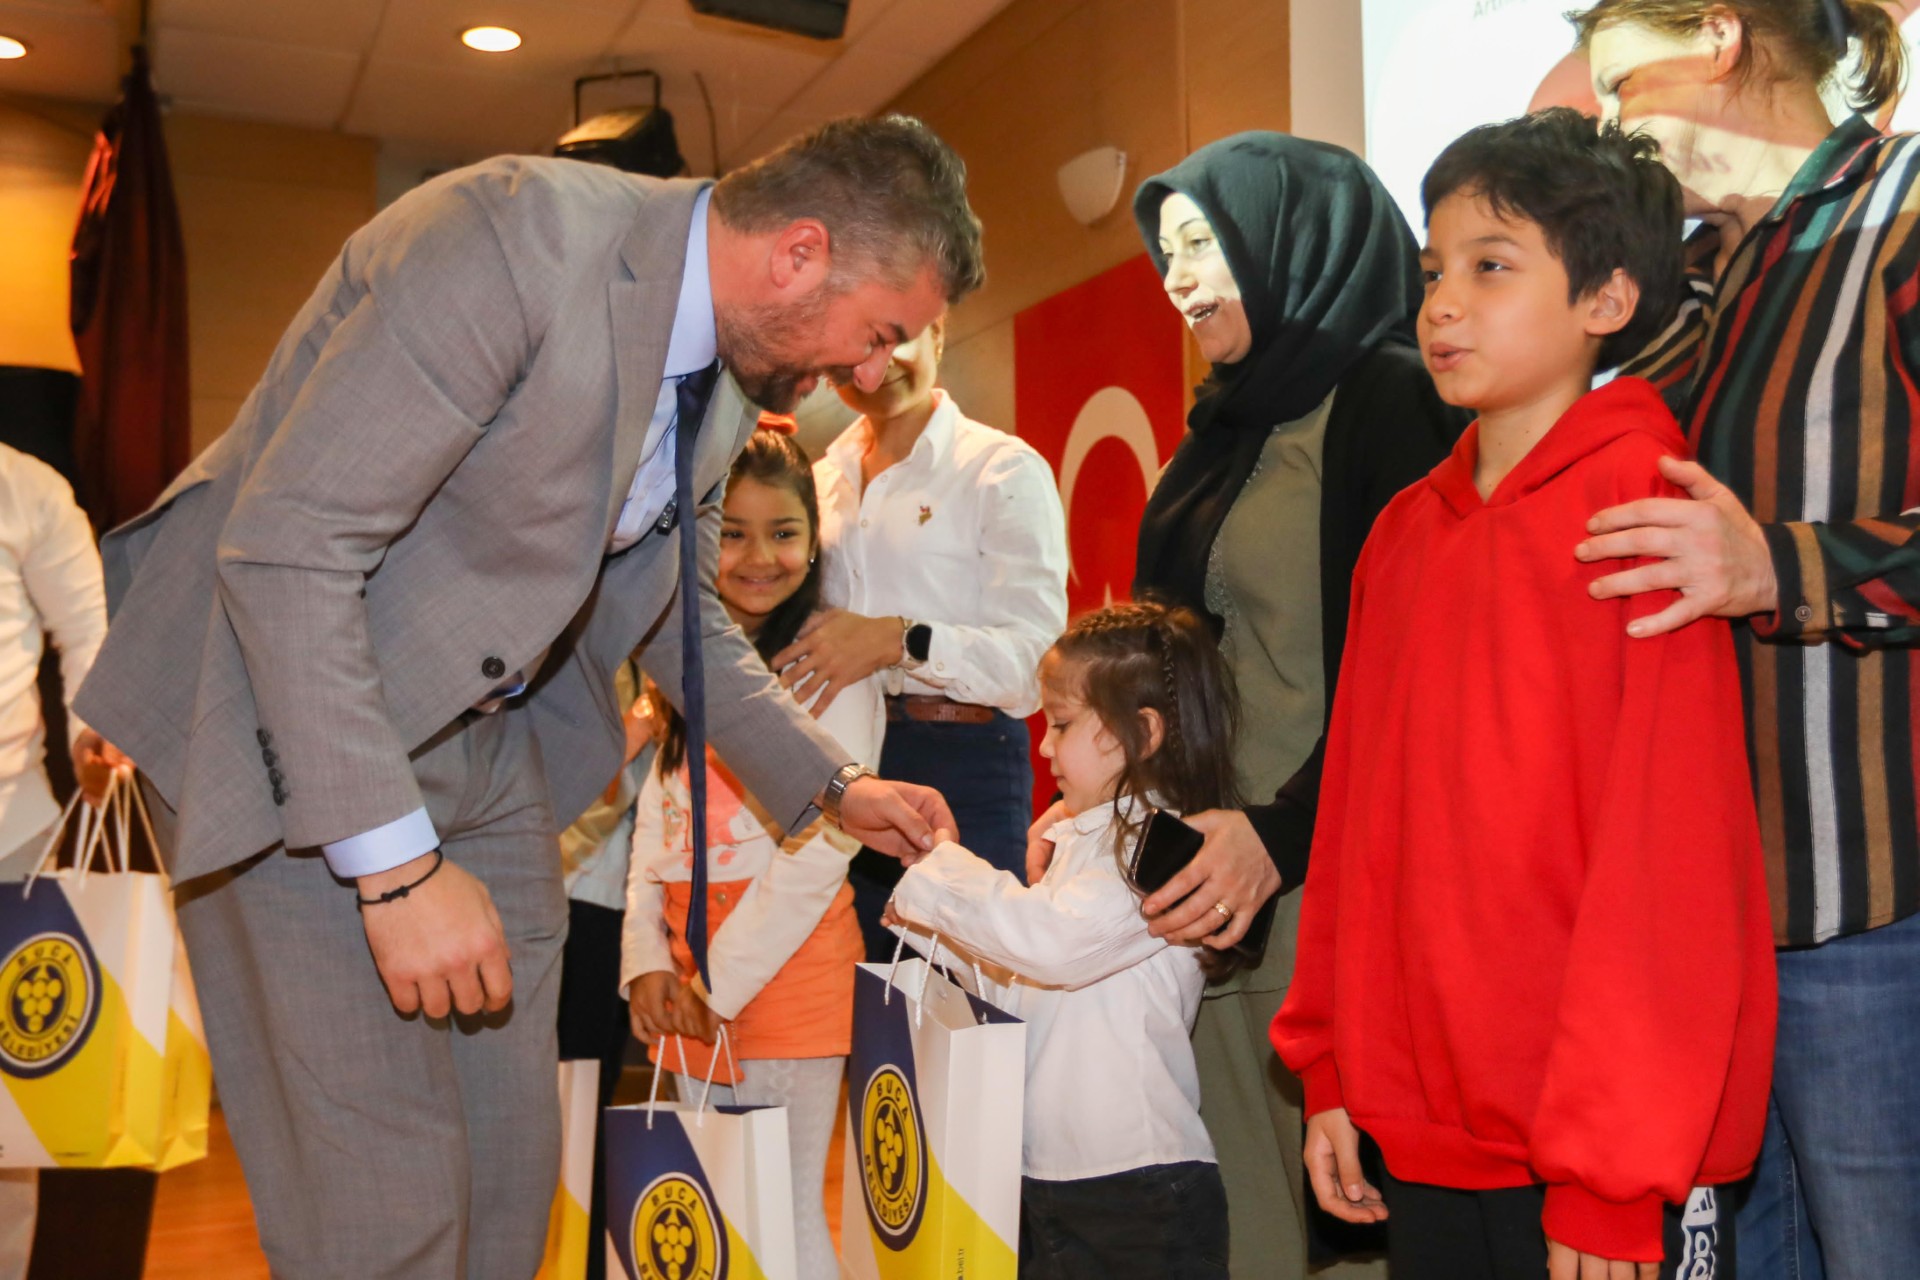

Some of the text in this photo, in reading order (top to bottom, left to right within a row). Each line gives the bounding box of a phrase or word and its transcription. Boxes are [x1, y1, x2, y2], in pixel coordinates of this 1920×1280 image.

[18, 945, 72, 967] BUCA
[876, 1079, 908, 1121] BUCA
[651, 1186, 697, 1212] BUCA
